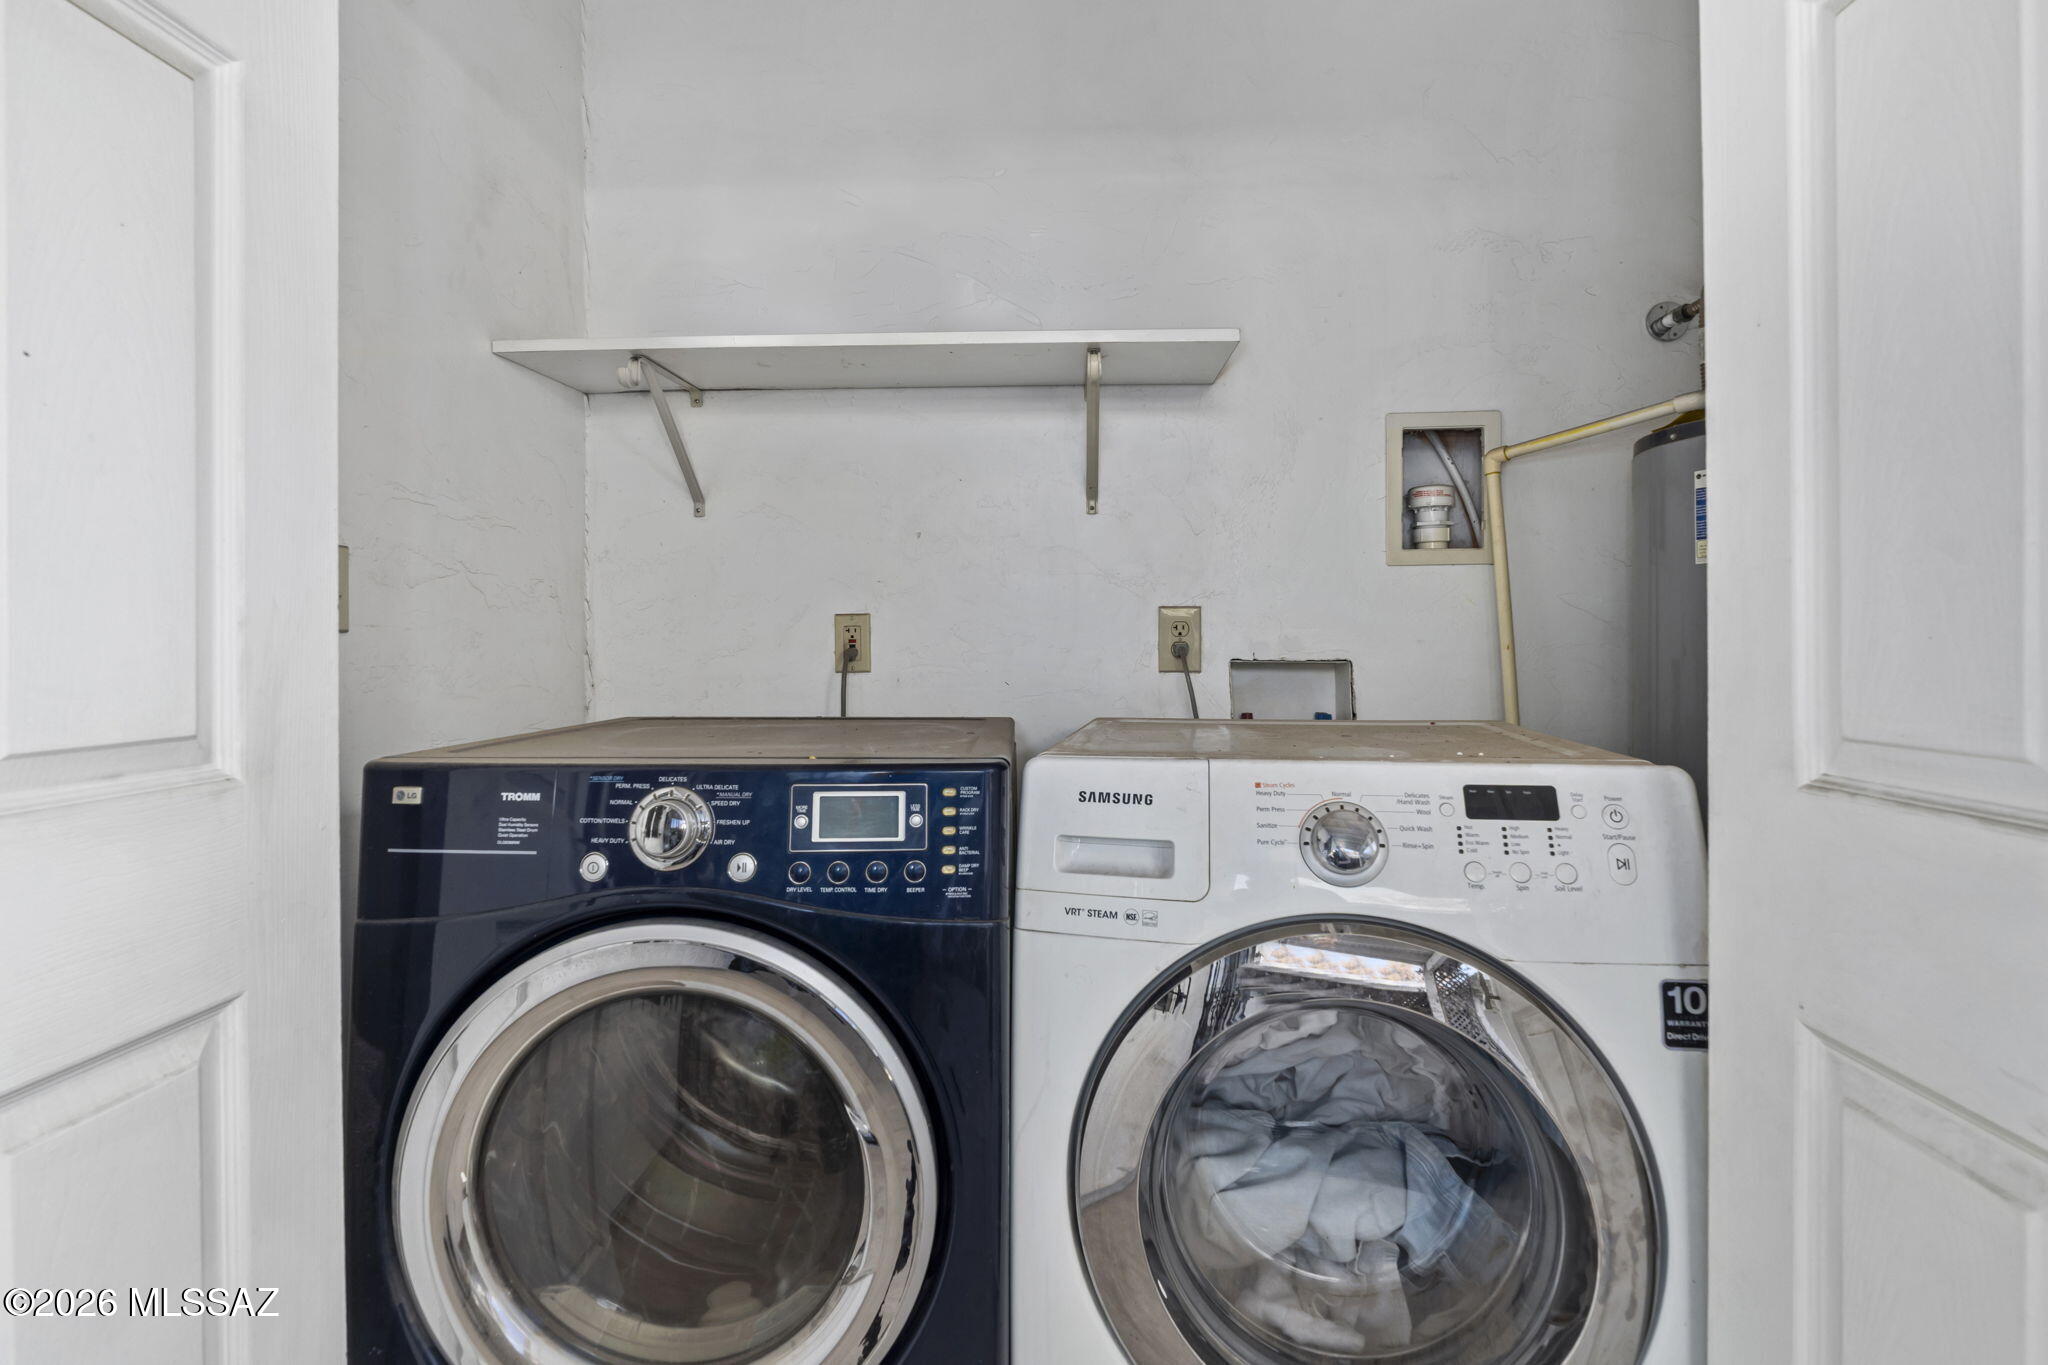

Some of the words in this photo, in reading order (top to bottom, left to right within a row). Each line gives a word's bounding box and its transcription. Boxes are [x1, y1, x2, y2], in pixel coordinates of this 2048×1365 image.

[500, 792, 541, 801] TROMM
[1078, 790, 1154, 806] SAMSUNG
[1516, 884, 1530, 892] Spin
[1087, 909, 1118, 919] STEAM
[1667, 985, 1708, 1015] 10
[1666, 1032, 1691, 1040] Direct
